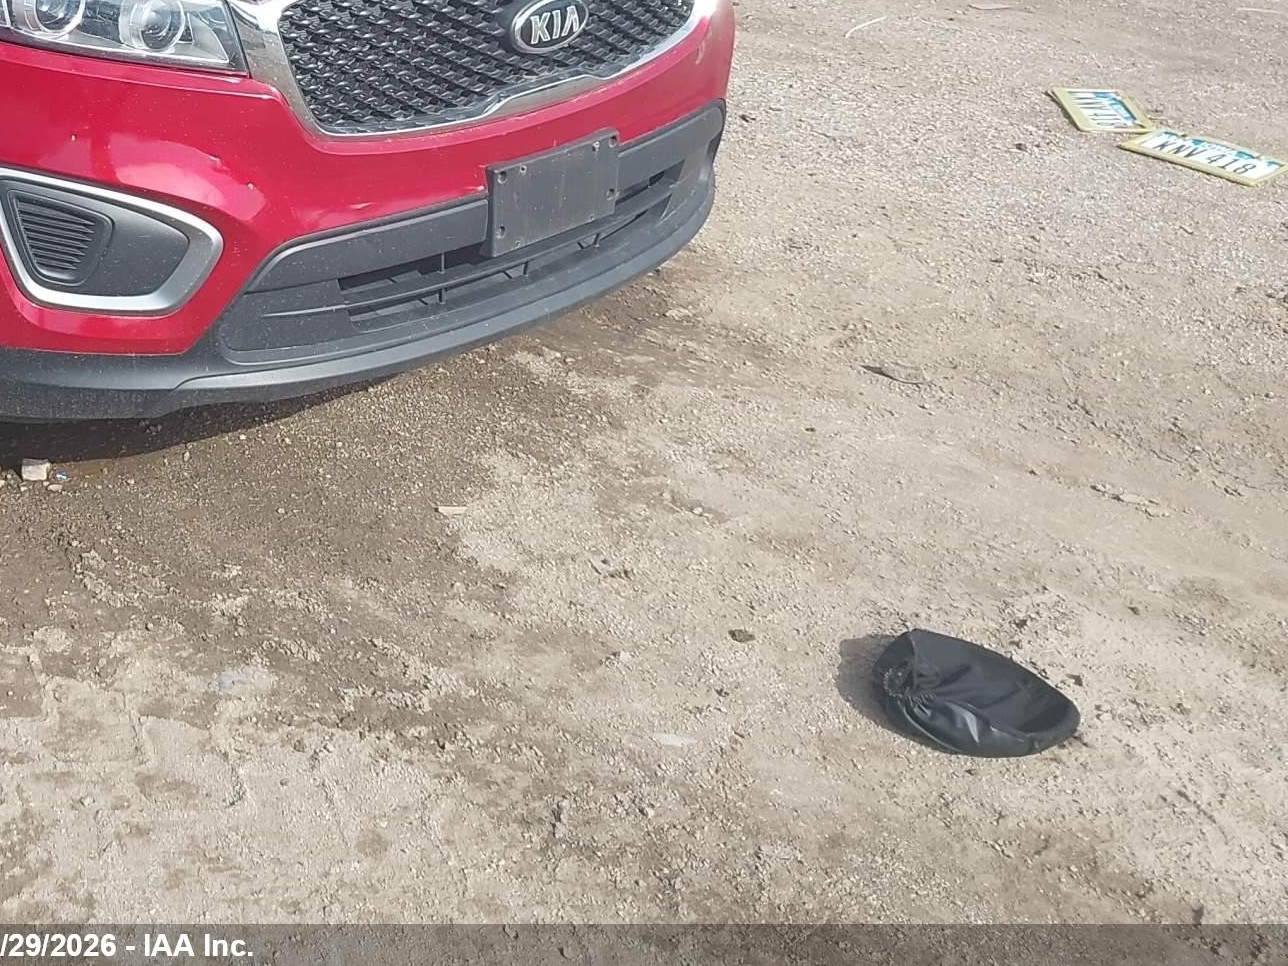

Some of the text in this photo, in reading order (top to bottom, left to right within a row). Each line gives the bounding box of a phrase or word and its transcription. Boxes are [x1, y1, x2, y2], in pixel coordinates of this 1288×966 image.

[530, 5, 580, 45] KIA
[1153, 140, 1208, 158] KNV
[1208, 153, 1257, 174] 418
